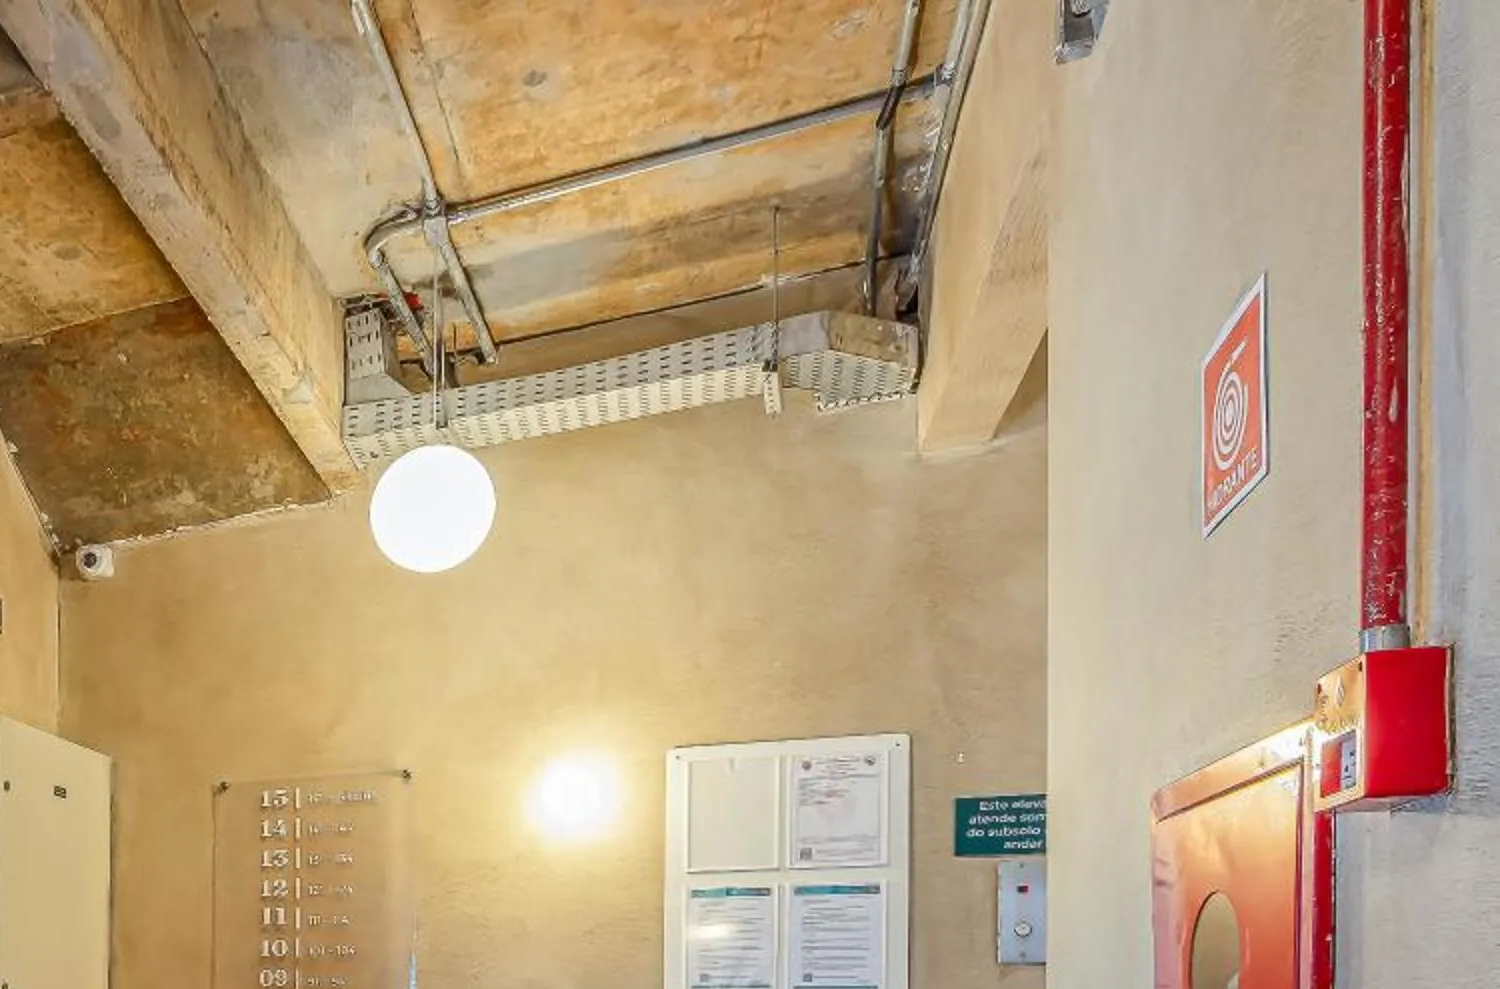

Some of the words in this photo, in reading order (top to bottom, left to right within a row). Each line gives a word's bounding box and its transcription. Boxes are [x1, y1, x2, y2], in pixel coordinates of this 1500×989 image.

[261, 789, 288, 807] 15
[979, 801, 1009, 811] Este
[261, 819, 287, 837] 14
[968, 814, 1017, 825] atende
[966, 828, 985, 838] do
[987, 826, 1041, 837] subsolo
[261, 849, 288, 867] 13
[261, 880, 288, 897] 12
[263, 907, 286, 925] 11
[261, 939, 288, 957] 10
[260, 969, 287, 987] 09
